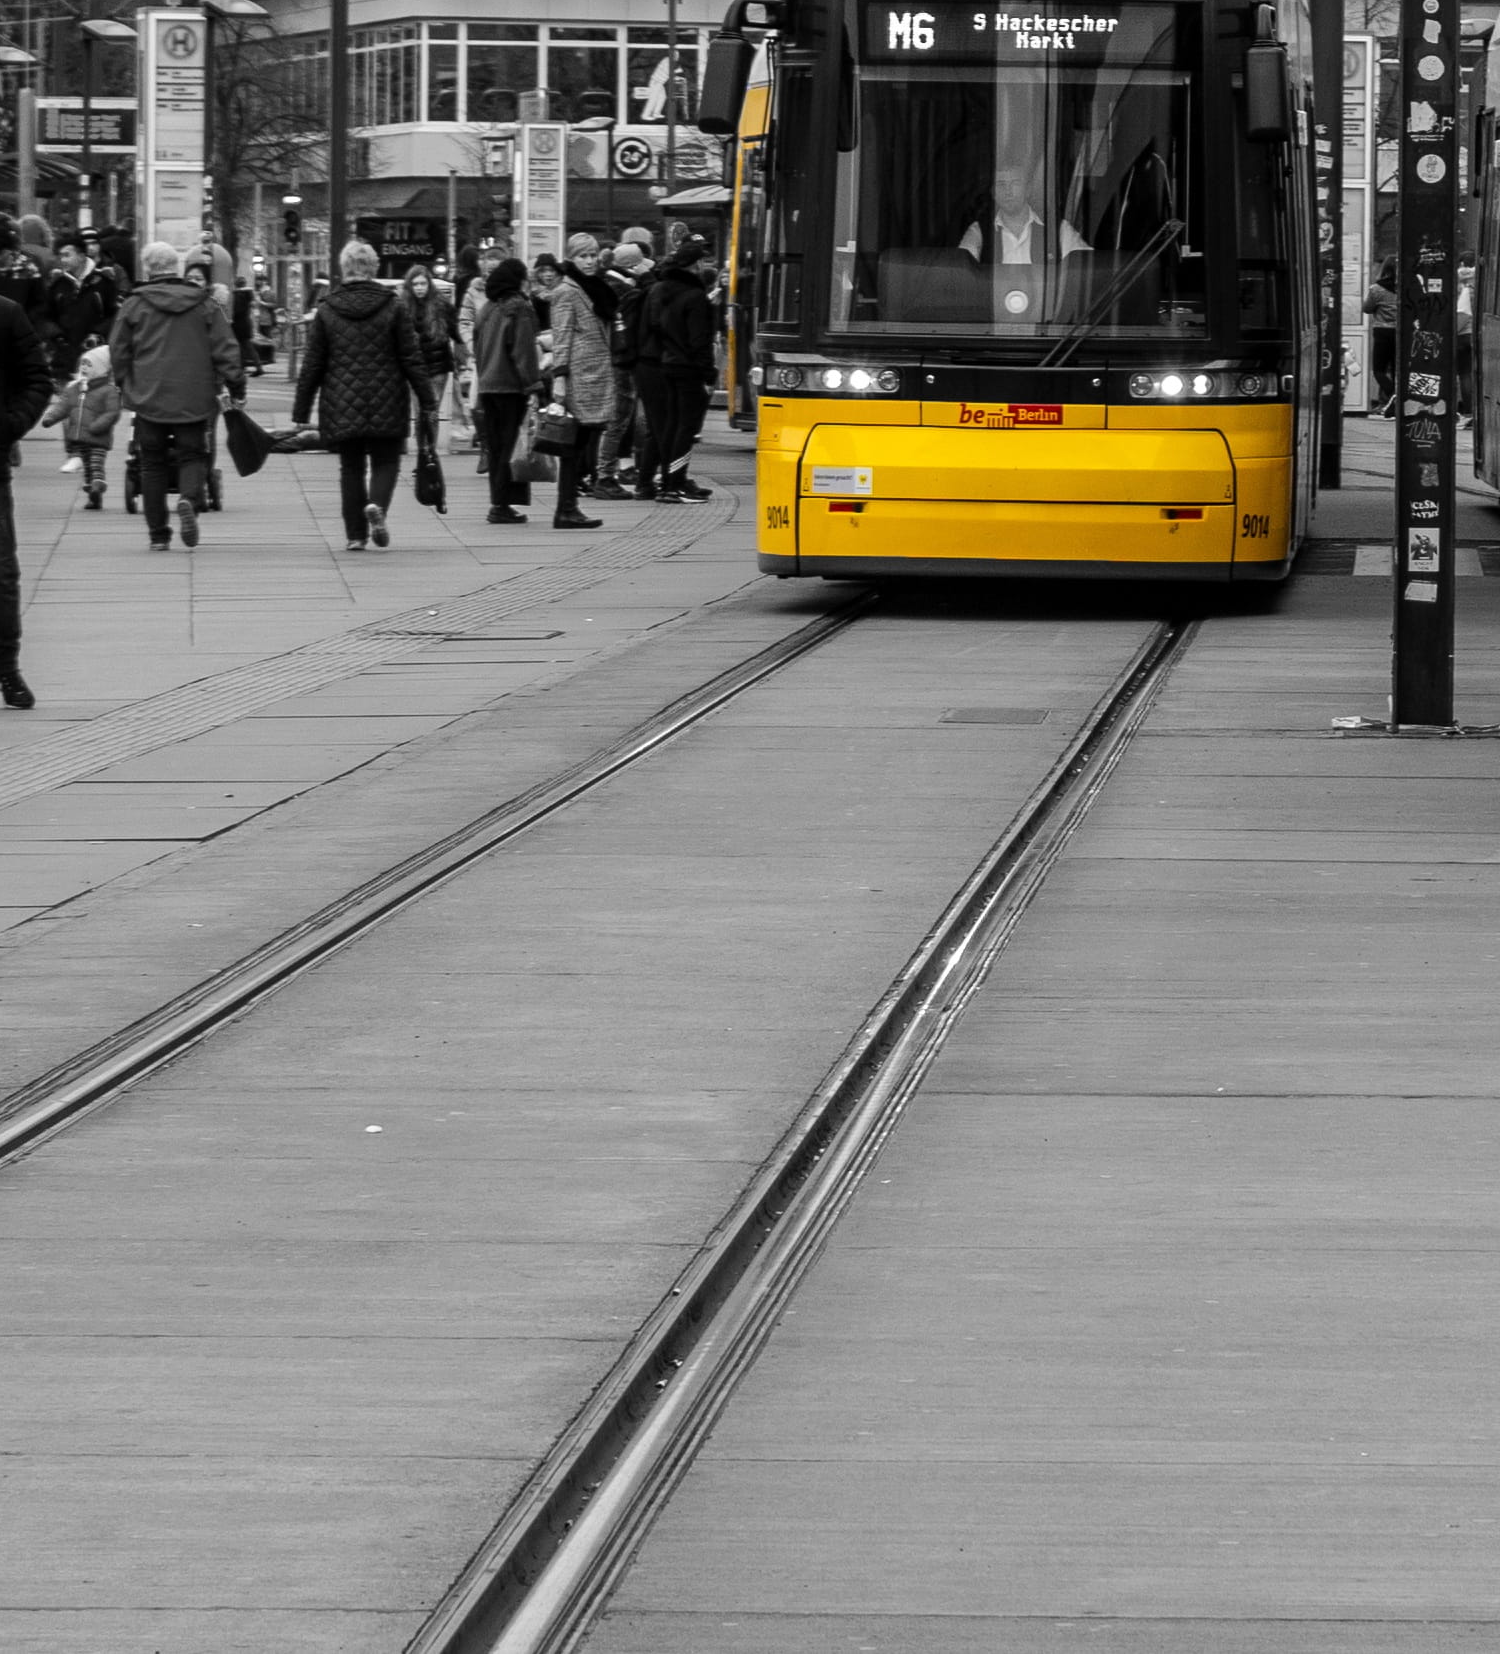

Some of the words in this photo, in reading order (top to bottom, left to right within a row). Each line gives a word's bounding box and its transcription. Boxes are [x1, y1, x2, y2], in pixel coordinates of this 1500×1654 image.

[888, 12, 935, 49] M6
[973, 13, 987, 30] S
[995, 14, 1118, 32] Hackescher
[1016, 32, 1075, 49] Markt
[381, 243, 434, 256] EINGANG
[959, 402, 985, 424] be
[1017, 408, 1059, 421] Berlin
[767, 506, 789, 529] 9014
[1242, 514, 1270, 538] 9014
